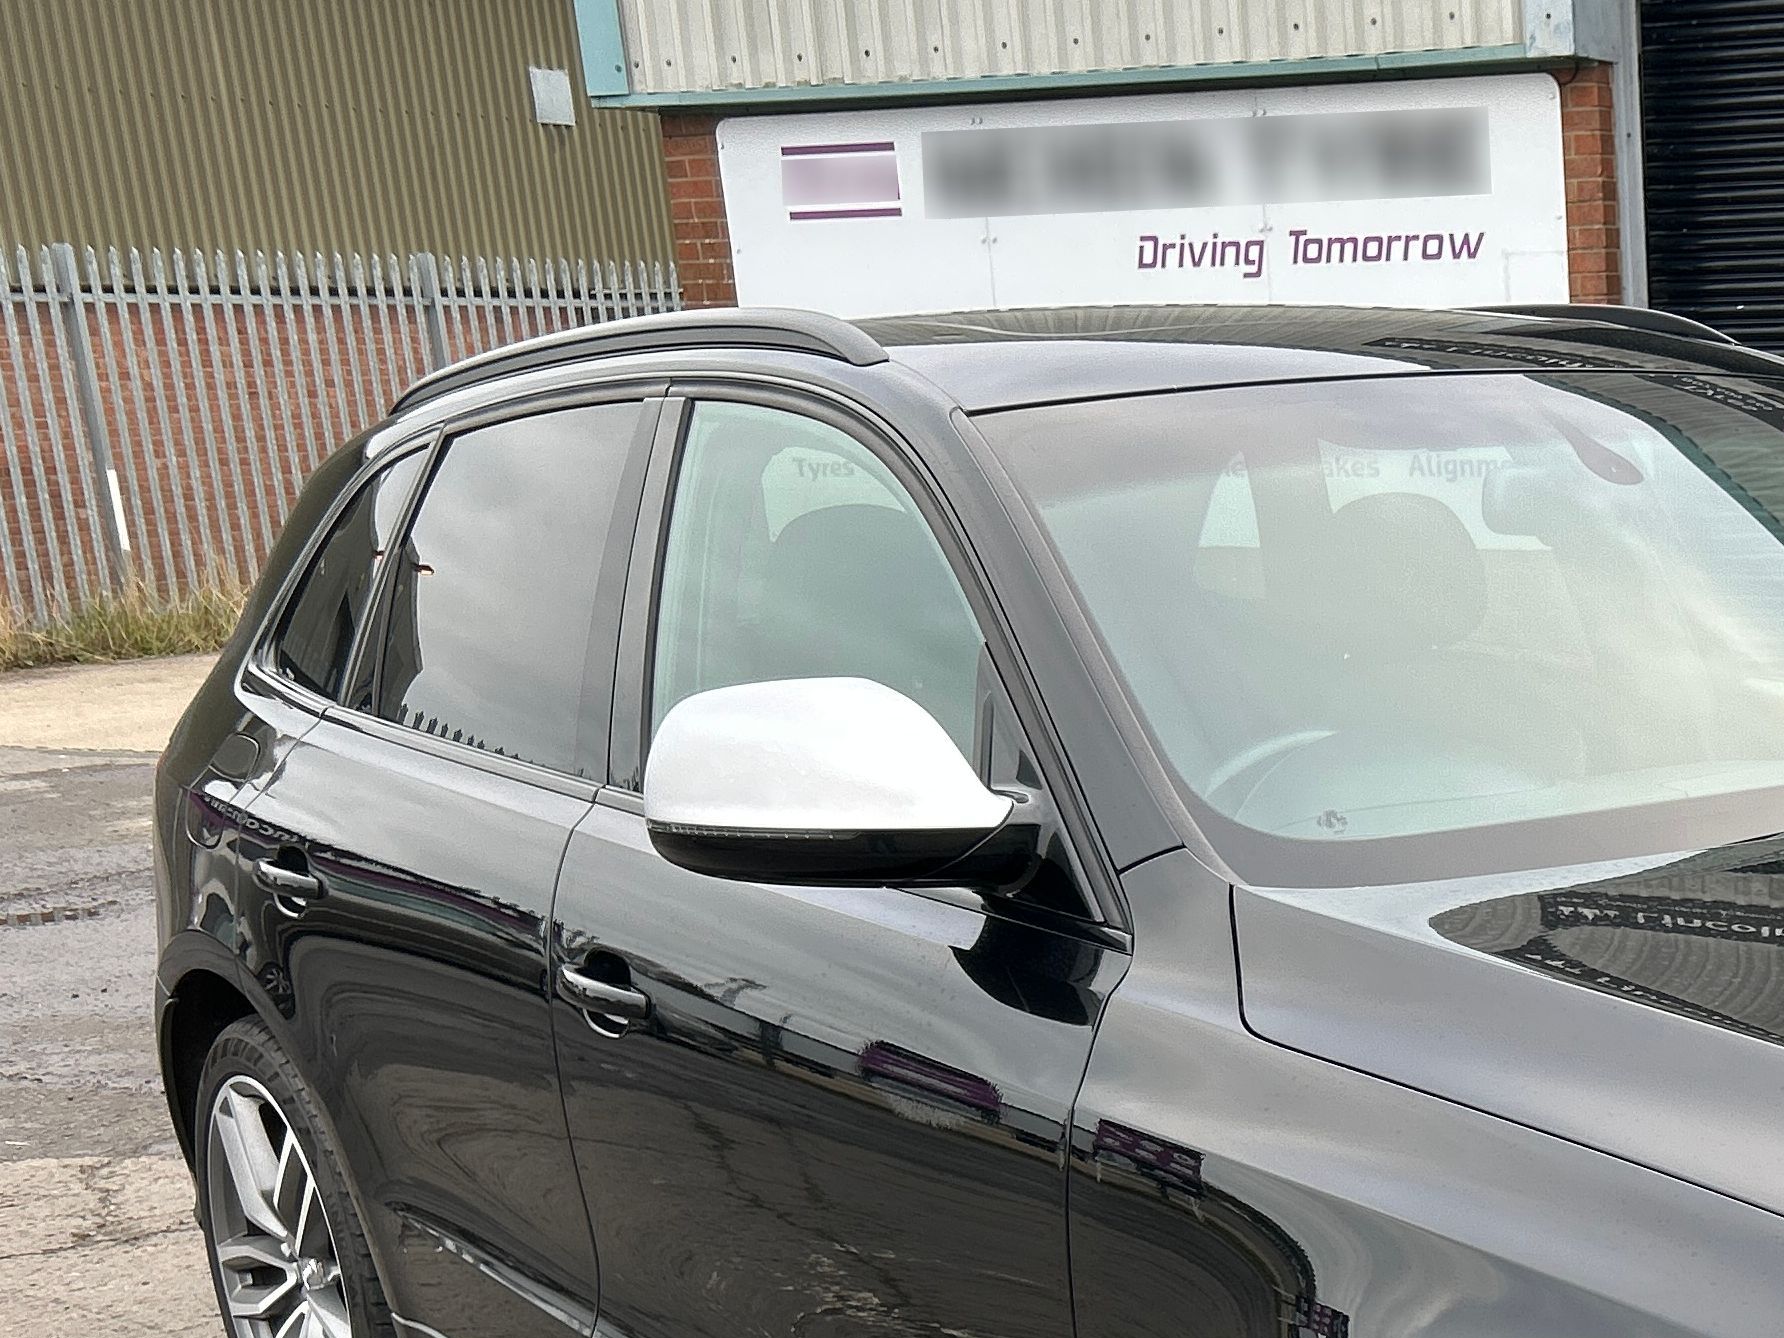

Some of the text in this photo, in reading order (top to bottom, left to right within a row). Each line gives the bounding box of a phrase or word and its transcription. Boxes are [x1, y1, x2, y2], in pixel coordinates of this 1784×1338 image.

[1137, 230, 1486, 278] Driving Tomorrow
[792, 456, 856, 482] Tyres
